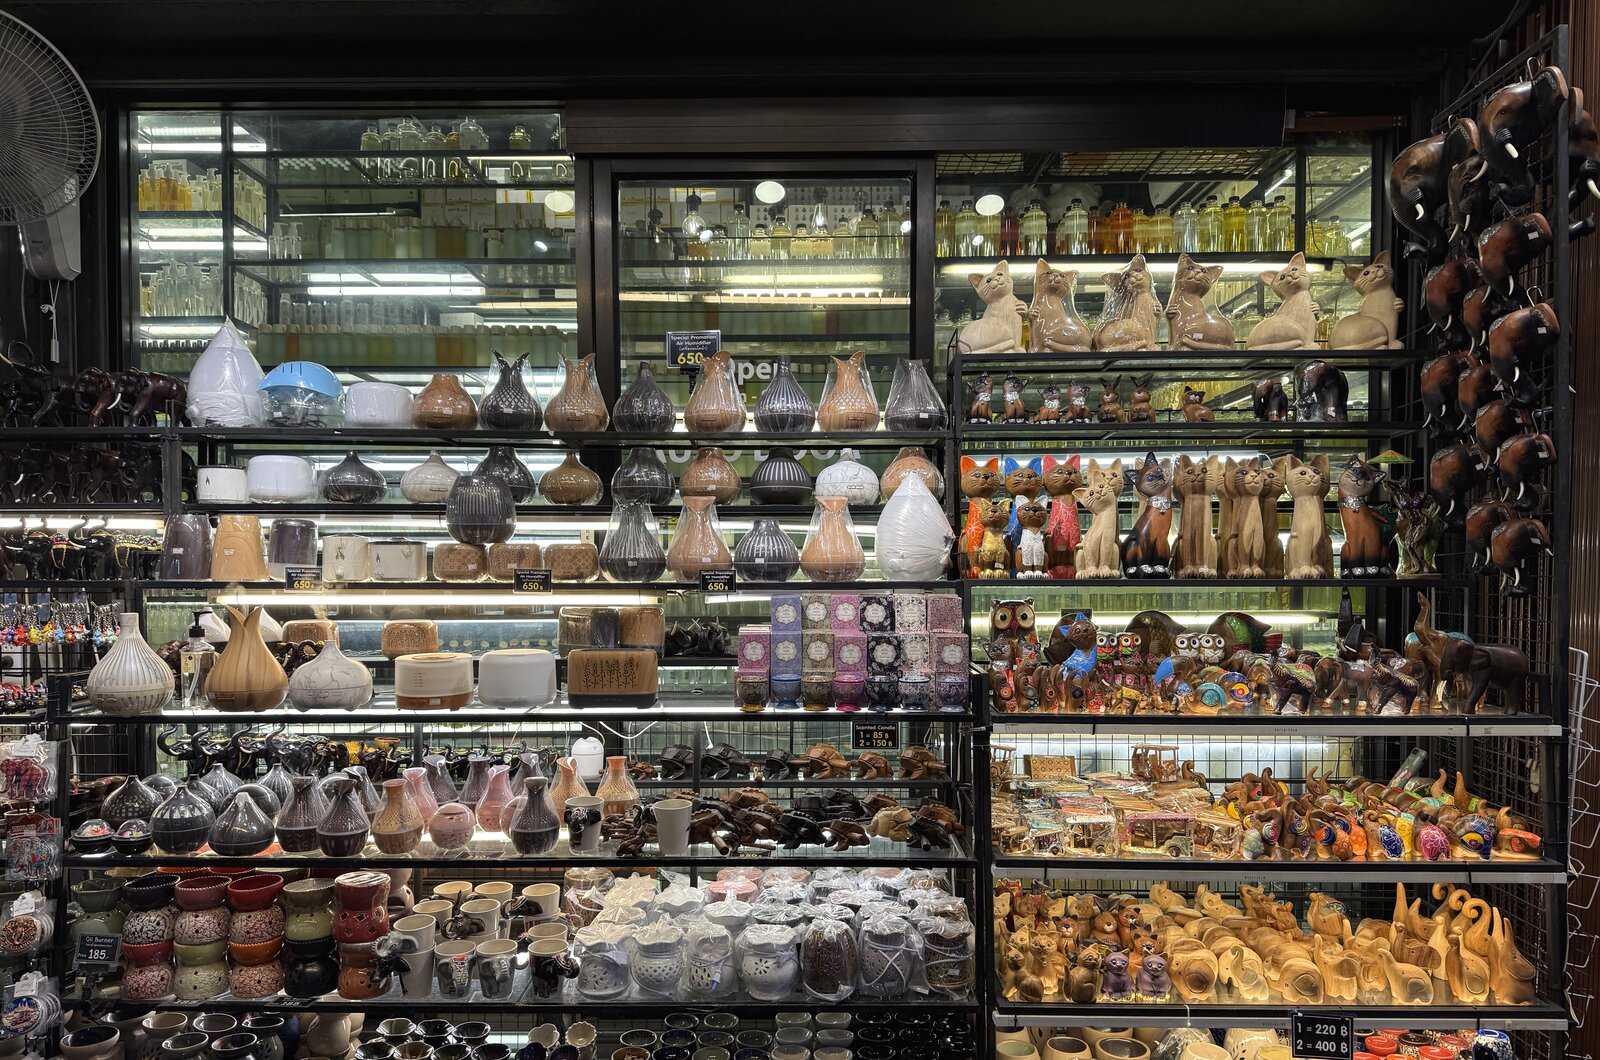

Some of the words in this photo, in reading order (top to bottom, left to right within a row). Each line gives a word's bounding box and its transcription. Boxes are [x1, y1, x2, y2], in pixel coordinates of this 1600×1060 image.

[677, 352, 704, 364] 650
[294, 581, 310, 589] 650
[522, 582, 539, 590] 650
[708, 582, 724, 591] 650
[1297, 1022, 1301, 1033] 1
[1315, 1024, 1336, 1036] 220
[1340, 1025, 1348, 1037] ฿
[1296, 1039, 1303, 1050] 2
[1315, 1040, 1336, 1052] 400
[1340, 1041, 1348, 1054] ฿
